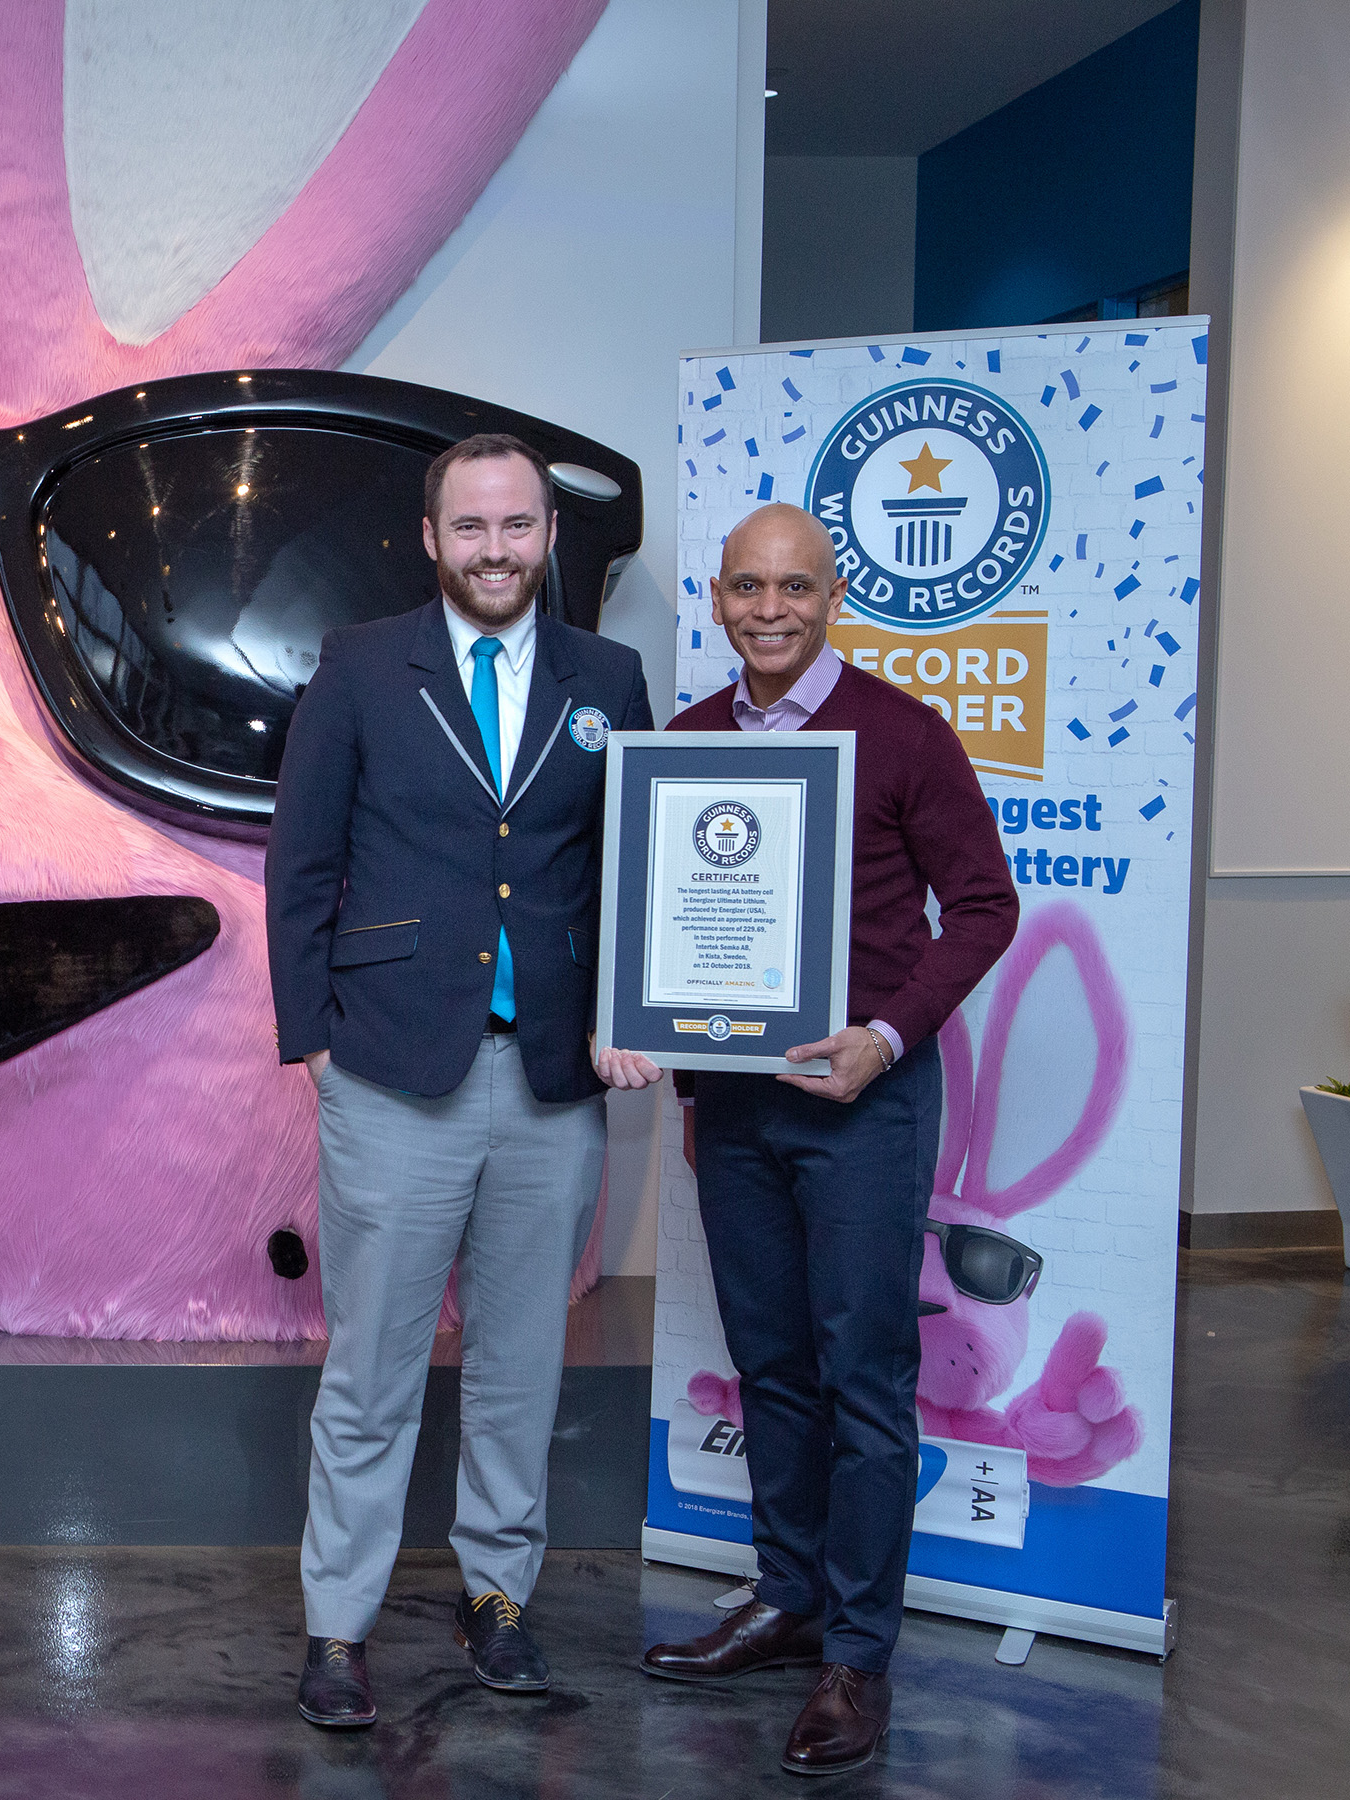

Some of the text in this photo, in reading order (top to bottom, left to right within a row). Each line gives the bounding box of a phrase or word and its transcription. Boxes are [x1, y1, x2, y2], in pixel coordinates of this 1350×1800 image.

[840, 394, 1016, 459] GUINNESS
[908, 485, 1035, 613] RECORDS
[574, 709, 606, 723] GUINNESS
[702, 804, 753, 823] GUINNESS
[986, 794, 1102, 834] gest
[696, 830, 758, 865] WORLD RECORDS
[691, 872, 760, 882] CERTIFICATE
[1005, 848, 1131, 895] ttery
[688, 887, 710, 895] longest
[710, 888, 731, 896] lasting
[740, 888, 762, 896] battery
[689, 897, 716, 905] Energizer
[710, 906, 718, 914] by
[718, 906, 746, 914] Energizer
[725, 916, 753, 924] approved
[753, 917, 777, 925] average
[747, 935, 754, 943] by
[723, 953, 748, 961] Sweden,
[679, 1023, 707, 1031] RECORD
[684, 1503, 699, 1511] 2018
[699, 1505, 726, 1517] Energizer
